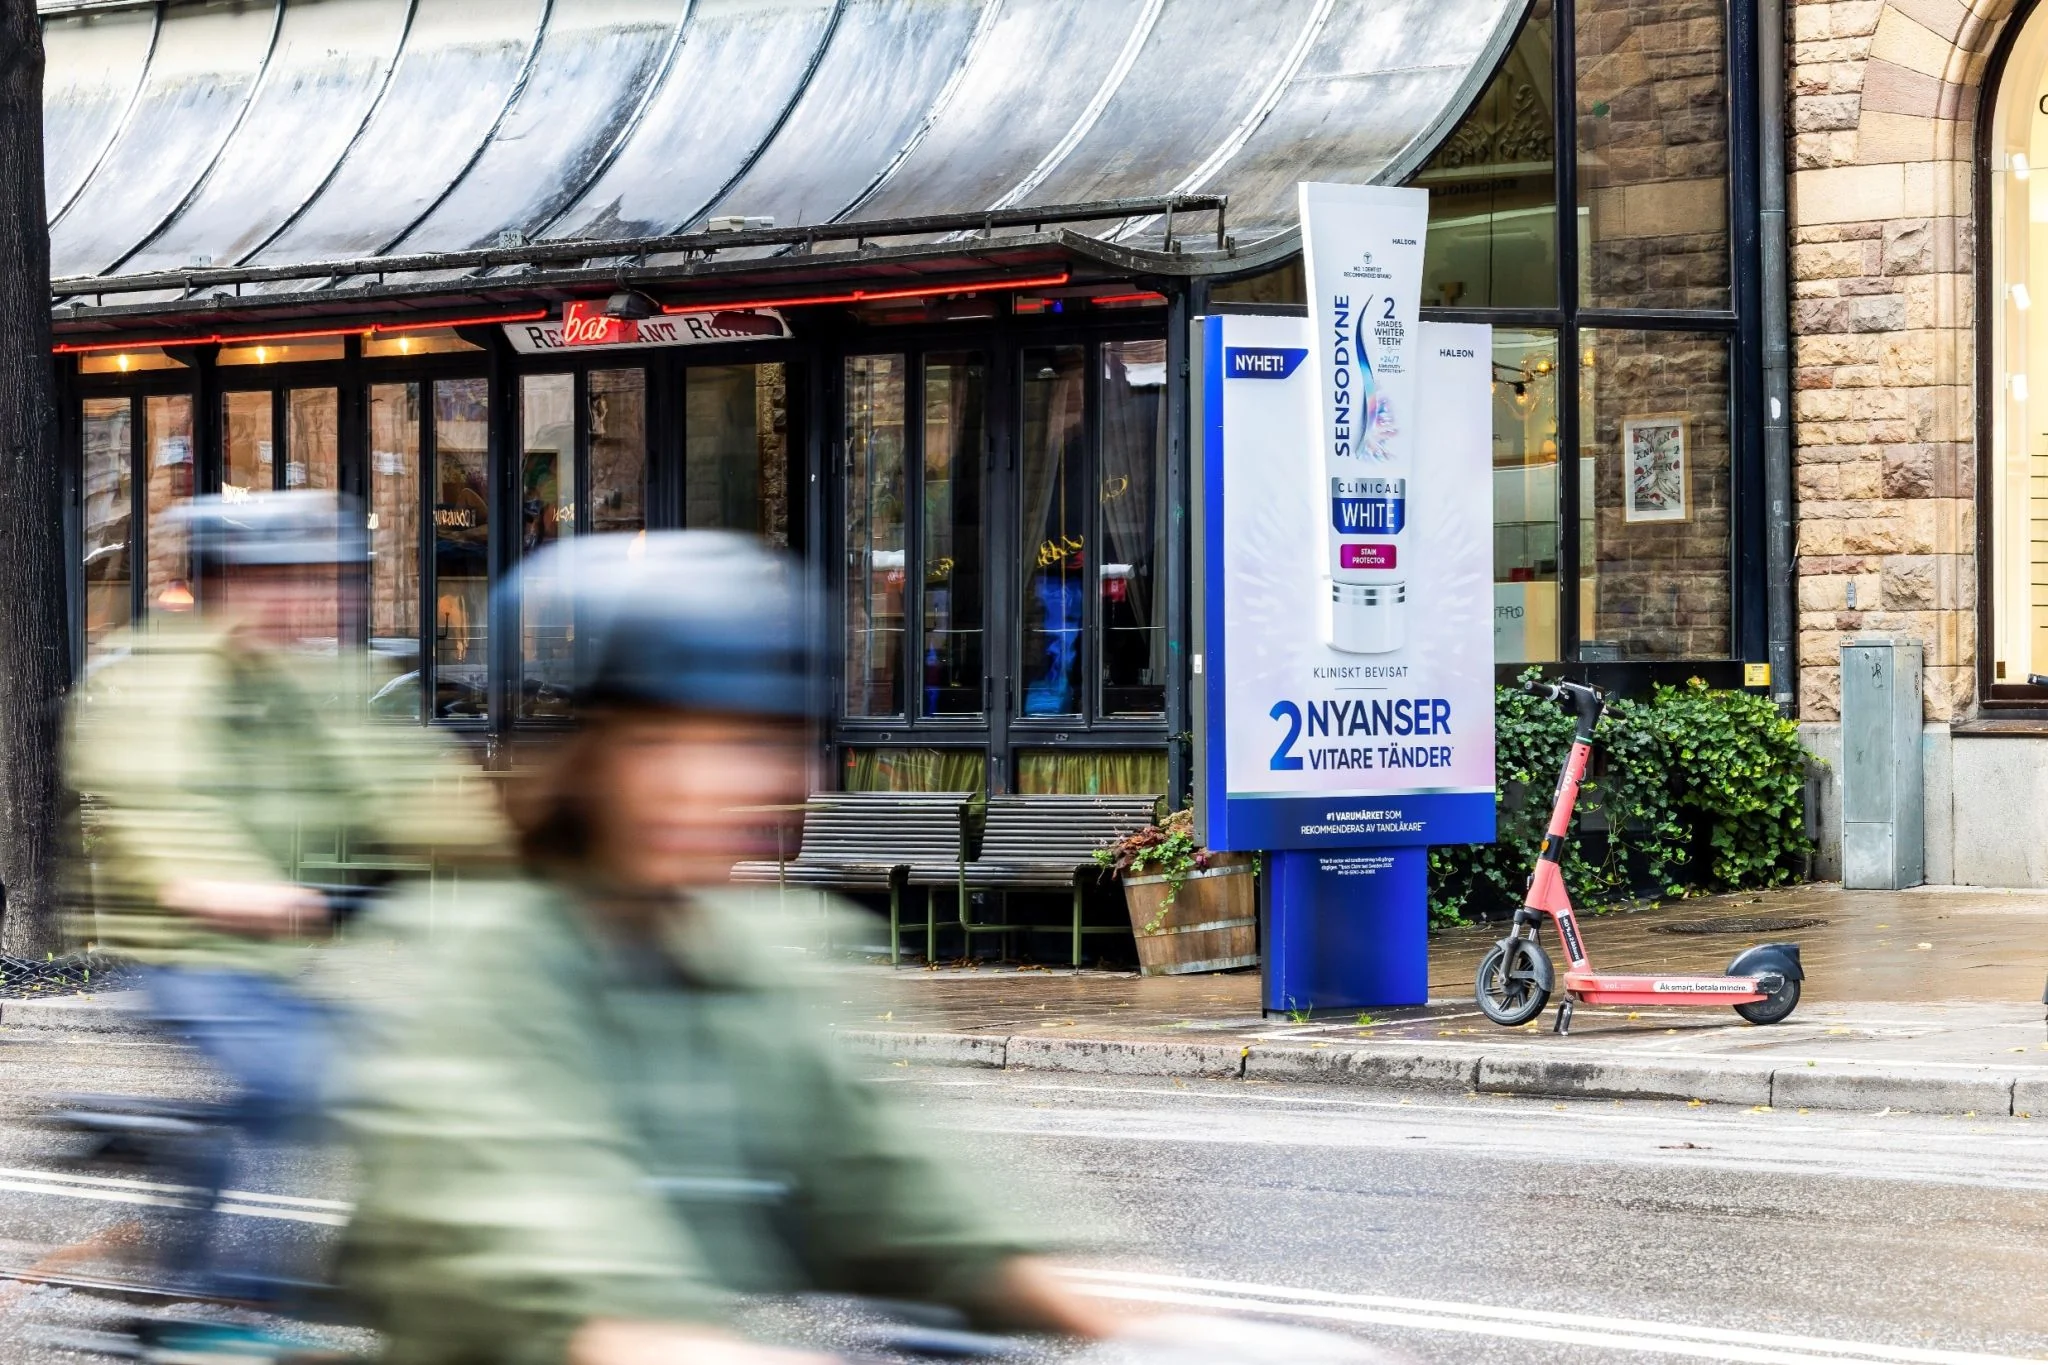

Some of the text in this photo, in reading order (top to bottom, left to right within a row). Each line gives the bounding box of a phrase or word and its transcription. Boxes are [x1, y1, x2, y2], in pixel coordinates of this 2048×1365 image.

[1383, 297, 1395, 319] 2
[565, 304, 622, 342] bar
[1376, 320, 1403, 328] SHADES
[1374, 328, 1405, 337] WHITER
[1439, 348, 1474, 358] HALEON
[1235, 354, 1284, 373] NYHET!
[1334, 295, 1350, 457] SENSODYNE
[1338, 483, 1400, 494] CLINICAL
[1341, 502, 1395, 529] WHITE
[1360, 548, 1377, 556] STAIN
[1352, 556, 1385, 565] PROTECTOR
[1313, 666, 1409, 679] KLINISKT BEVISAT
[1307, 698, 1452, 737] NYANSER
[1269, 699, 1304, 771] 2
[1309, 748, 1373, 770] VITARE
[1335, 809, 1384, 821] VARUMÄRKET
[1384, 810, 1402, 820] SOM
[1300, 823, 1364, 835] REKOMMENDERAS
[1365, 823, 1376, 833] AV
[1659, 982, 1747, 992] Åk smart, betala mindre.
